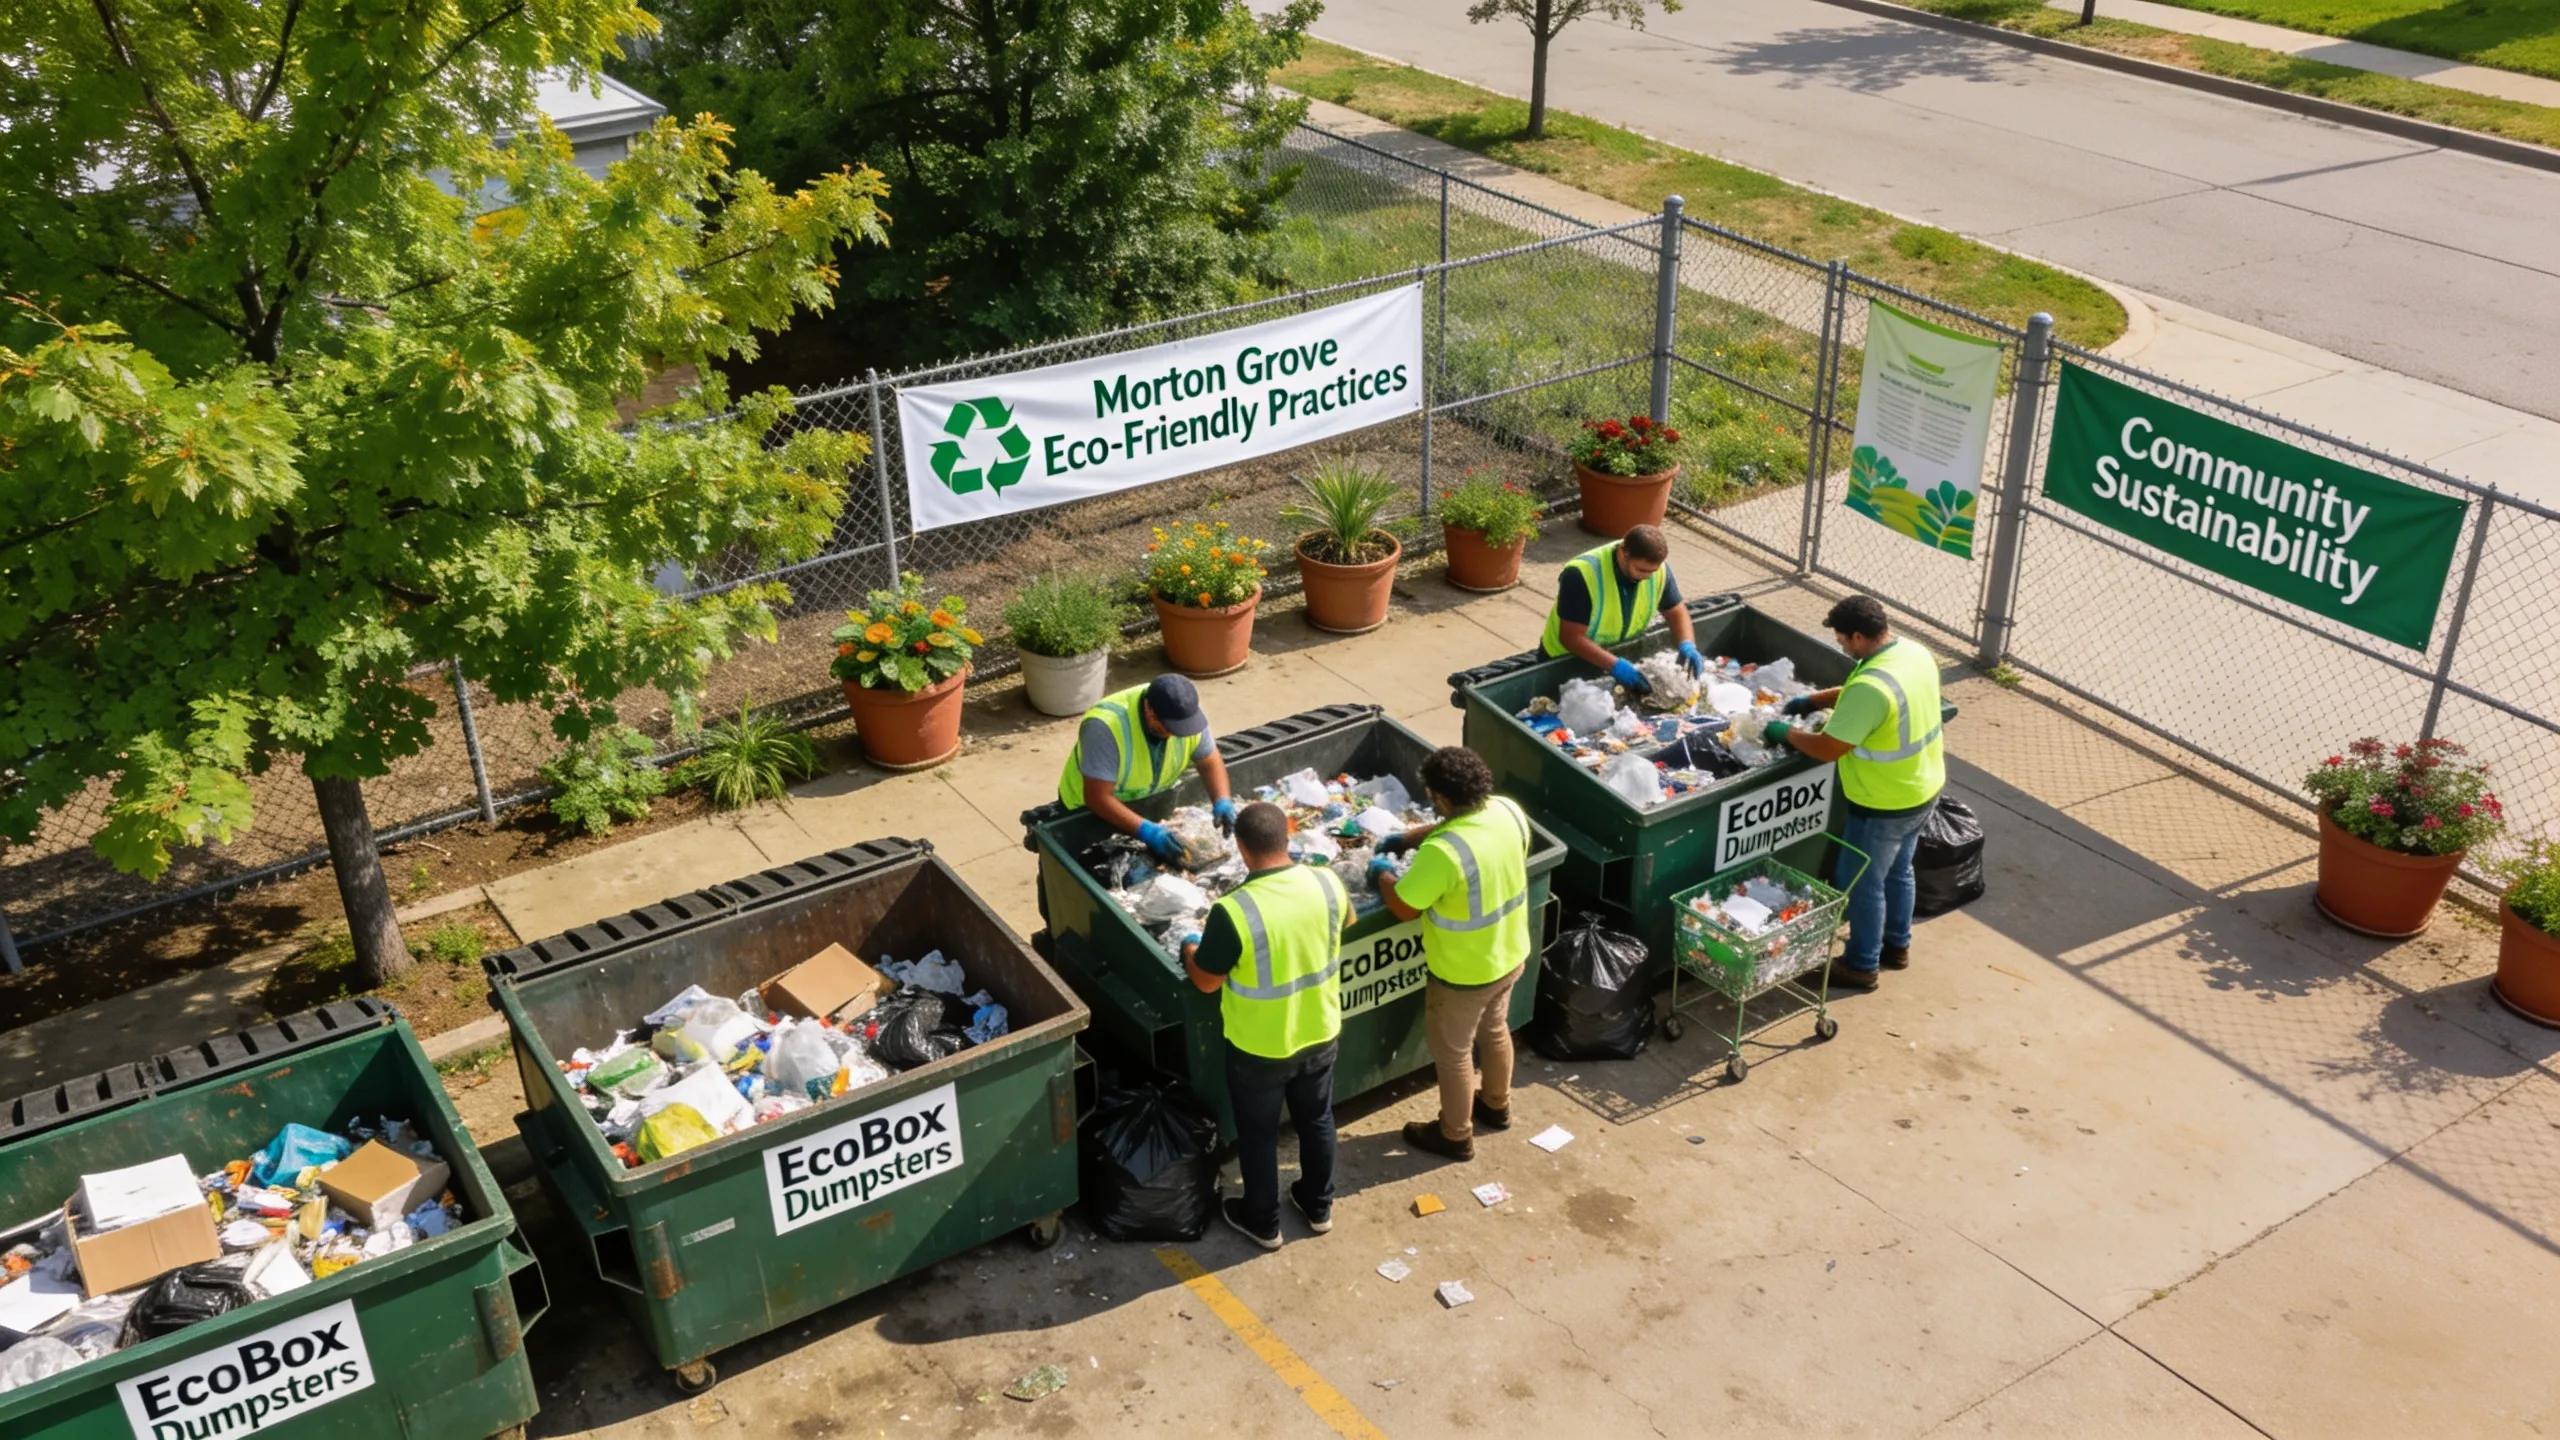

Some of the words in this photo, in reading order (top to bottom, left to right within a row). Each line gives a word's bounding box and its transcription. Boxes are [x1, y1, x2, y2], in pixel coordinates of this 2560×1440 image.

[1043, 398, 1257, 476] Eco-Friendly
[1269, 363, 1407, 426] Practices
[1093, 363, 1226, 419] Morton
[1236, 338, 1338, 386] Grove
[2120, 417, 2371, 544] Community
[2092, 455, 2379, 604] Sustainability
[1727, 778, 1826, 834] EcoBox
[1340, 934, 1425, 984] coBox
[778, 1103, 946, 1189] EcoBox
[783, 1141, 952, 1222] Dumpsters
[136, 1321, 349, 1421] EcoBox
